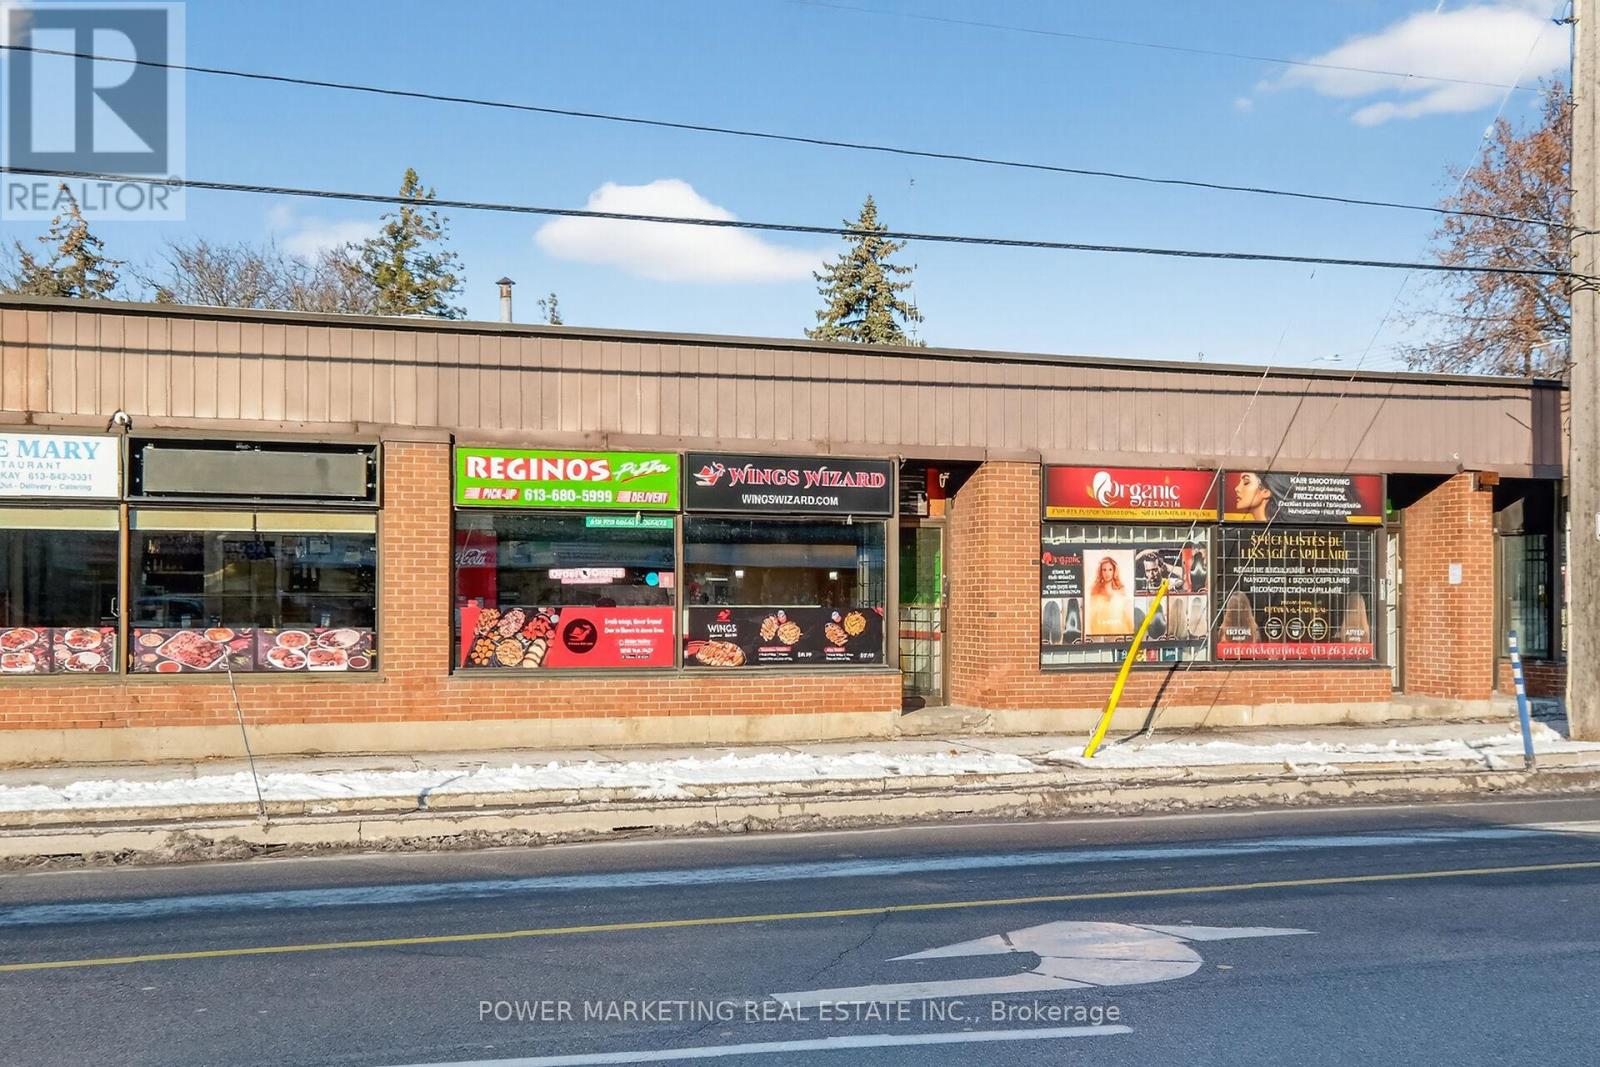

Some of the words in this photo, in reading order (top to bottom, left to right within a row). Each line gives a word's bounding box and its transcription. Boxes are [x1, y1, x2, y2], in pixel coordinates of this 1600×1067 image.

[17, 440, 100, 460] MARY
[2, 461, 62, 470] TAURANT
[466, 456, 610, 481] REGINOS
[613, 460, 671, 480] Pizza
[728, 464, 799, 487] WINGS
[803, 466, 886, 489] WIZARD
[525, 488, 612, 502] 613-680-5999
[741, 494, 839, 506] WINGSWIZARD.COM
[1314, 493, 1347, 501] CONTROL
[707, 624, 737, 633] WINGS
